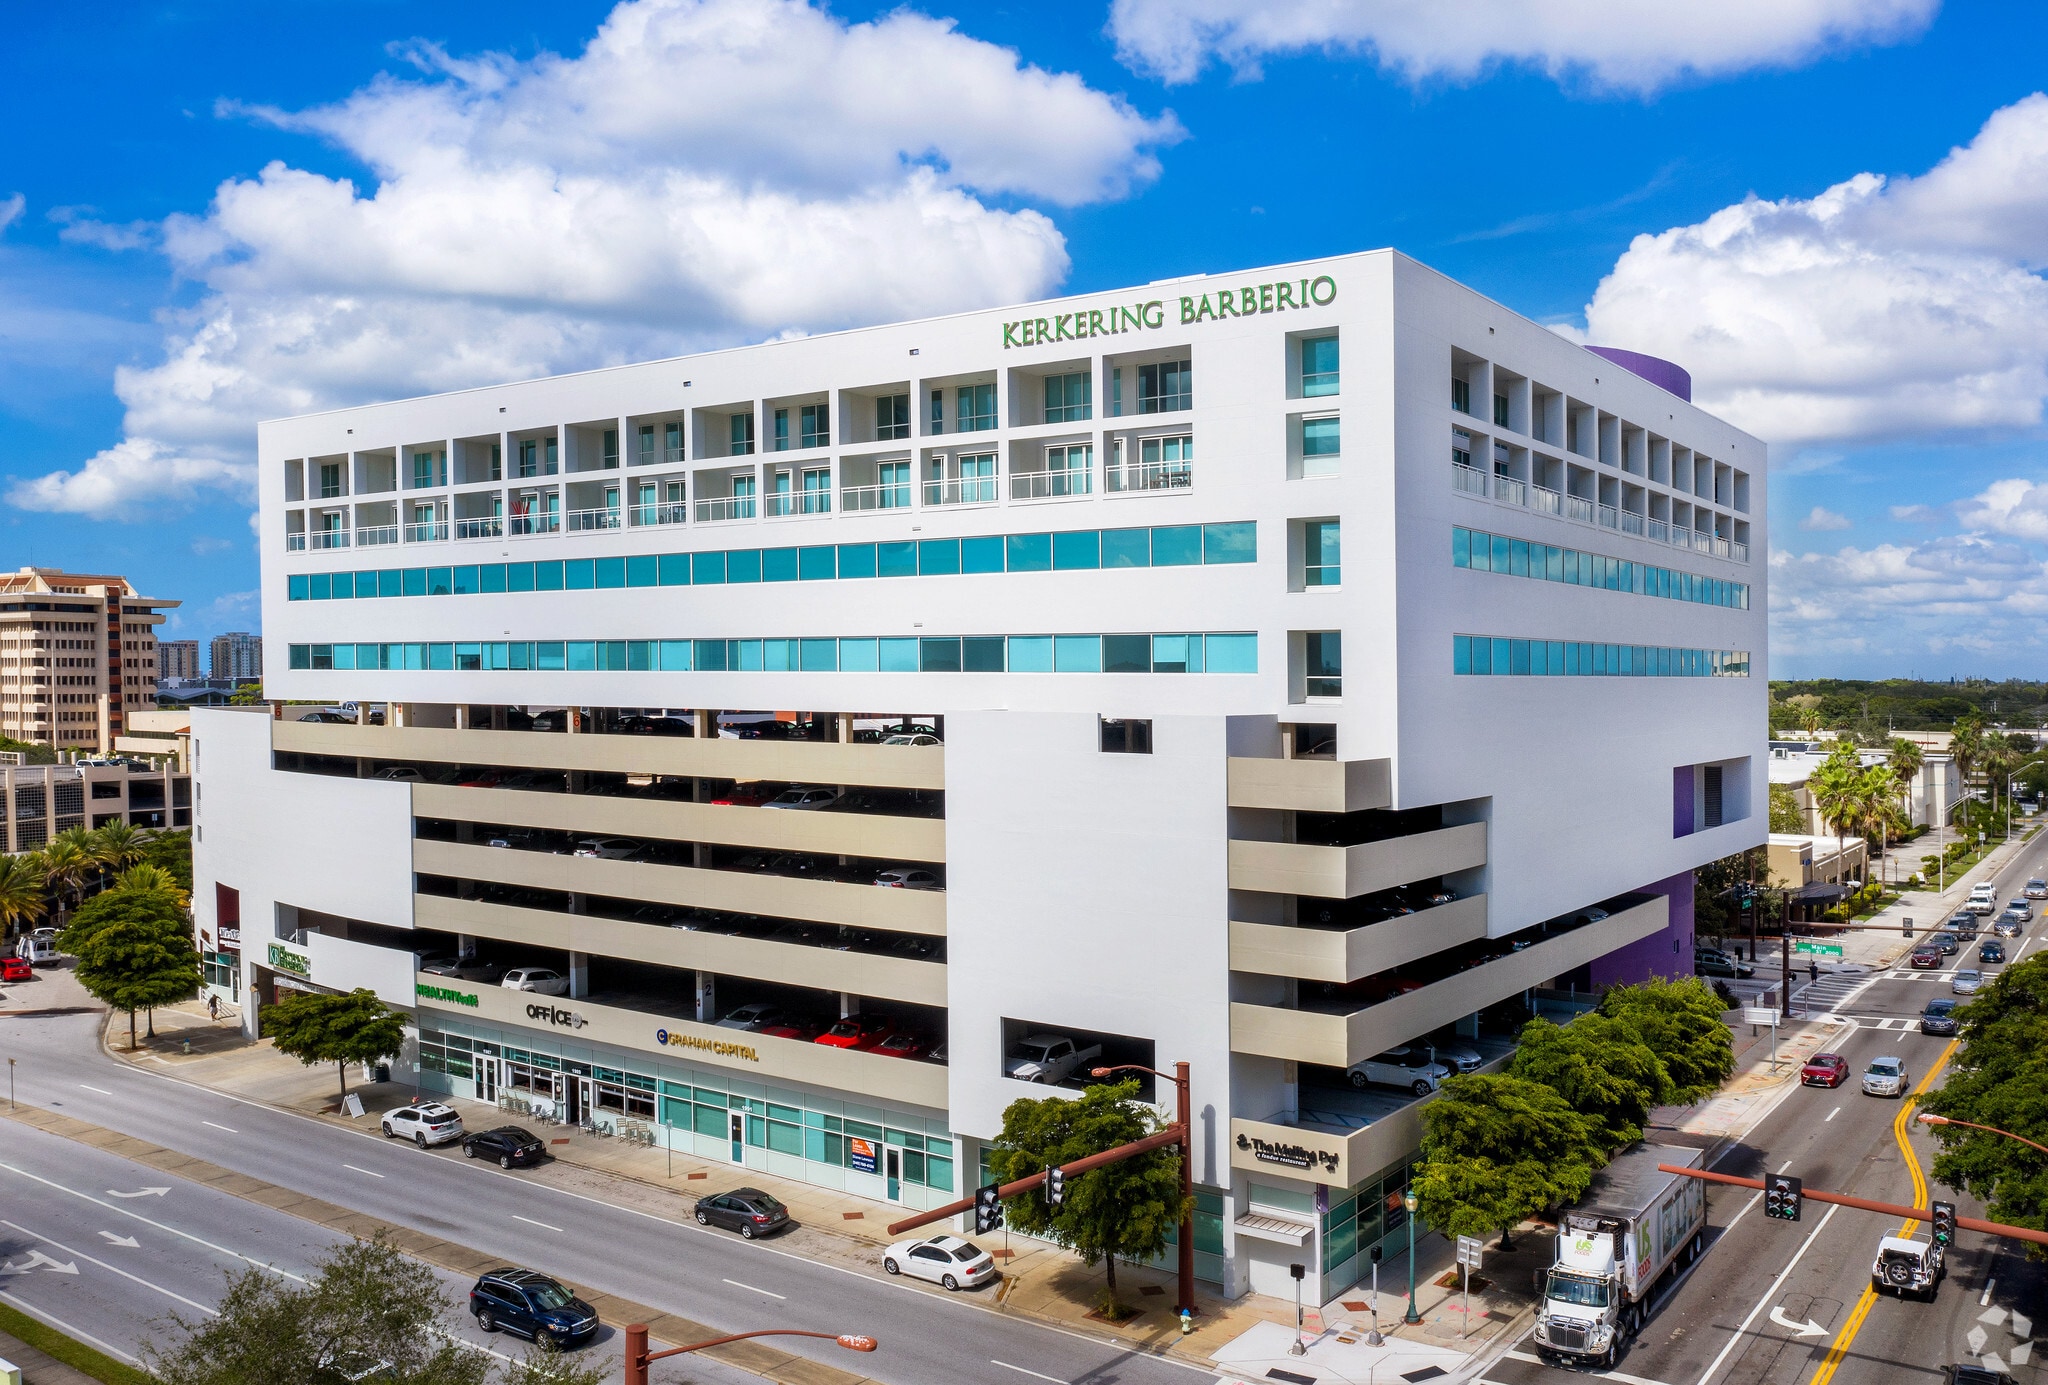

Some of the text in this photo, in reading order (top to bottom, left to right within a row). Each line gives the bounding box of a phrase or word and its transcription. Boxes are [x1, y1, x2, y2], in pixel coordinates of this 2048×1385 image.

[1002, 275, 1337, 347] KERKERING BARBERIO
[574, 715, 580, 727] 6
[270, 945, 279, 965] KB
[467, 945, 474, 957] 2
[705, 984, 712, 997] 2
[526, 1003, 572, 1027] OFFICE
[668, 1032, 712, 1052] GRAHAM
[713, 1041, 759, 1062] CAPITAL
[1251, 1138, 1274, 1153] The
[1261, 1153, 1279, 1161] fondue
